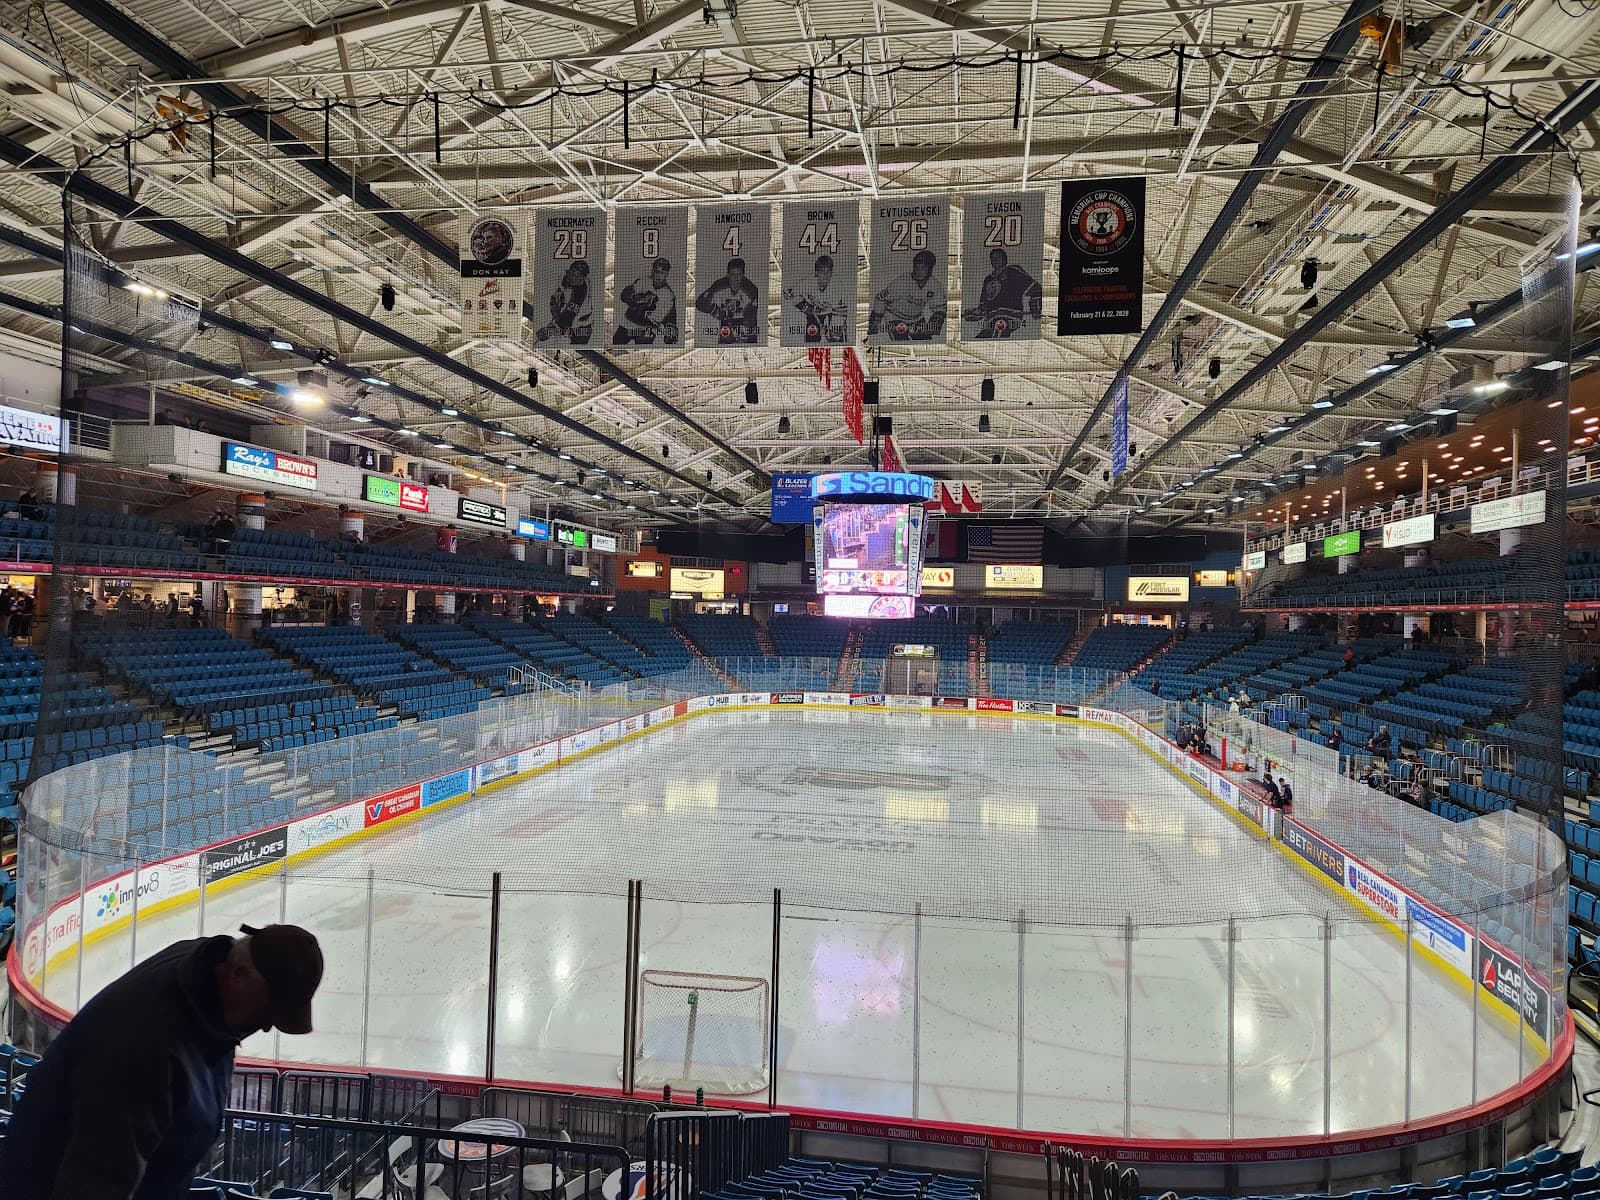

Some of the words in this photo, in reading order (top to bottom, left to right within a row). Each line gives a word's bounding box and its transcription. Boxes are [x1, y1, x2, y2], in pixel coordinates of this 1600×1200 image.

[636, 215, 667, 226] RECCHI
[880, 205, 940, 218] EVTUSHEVSKI
[987, 202, 1022, 213] EVASON
[1071, 196, 1095, 225] MEMORIAL
[1094, 192, 1108, 201] CUP
[1108, 193, 1134, 222] CHAMPIONS
[553, 229, 588, 260] 28
[642, 228, 660, 258] 8
[722, 226, 743, 257] 4
[799, 223, 841, 254] 44
[891, 218, 928, 251] 26
[984, 214, 1023, 247] 20
[1082, 265, 1120, 275] kamloops
[1070, 311, 1094, 319] February
[233, 446, 270, 467] Ray's
[276, 458, 316, 476] BROWN'S
[716, 696, 730, 704] HUB
[977, 700, 989, 708] Tim
[989, 701, 1012, 710] Hortons
[206, 849, 256, 875] ORIGINAL
[1289, 829, 1343, 877] BETRIVERS
[119, 871, 160, 905] innov8
[1357, 870, 1369, 883] REAL
[1370, 879, 1398, 905] CANADIAN
[1357, 882, 1399, 919] SUPERSTORE
[1497, 962, 1538, 1010] LARER
